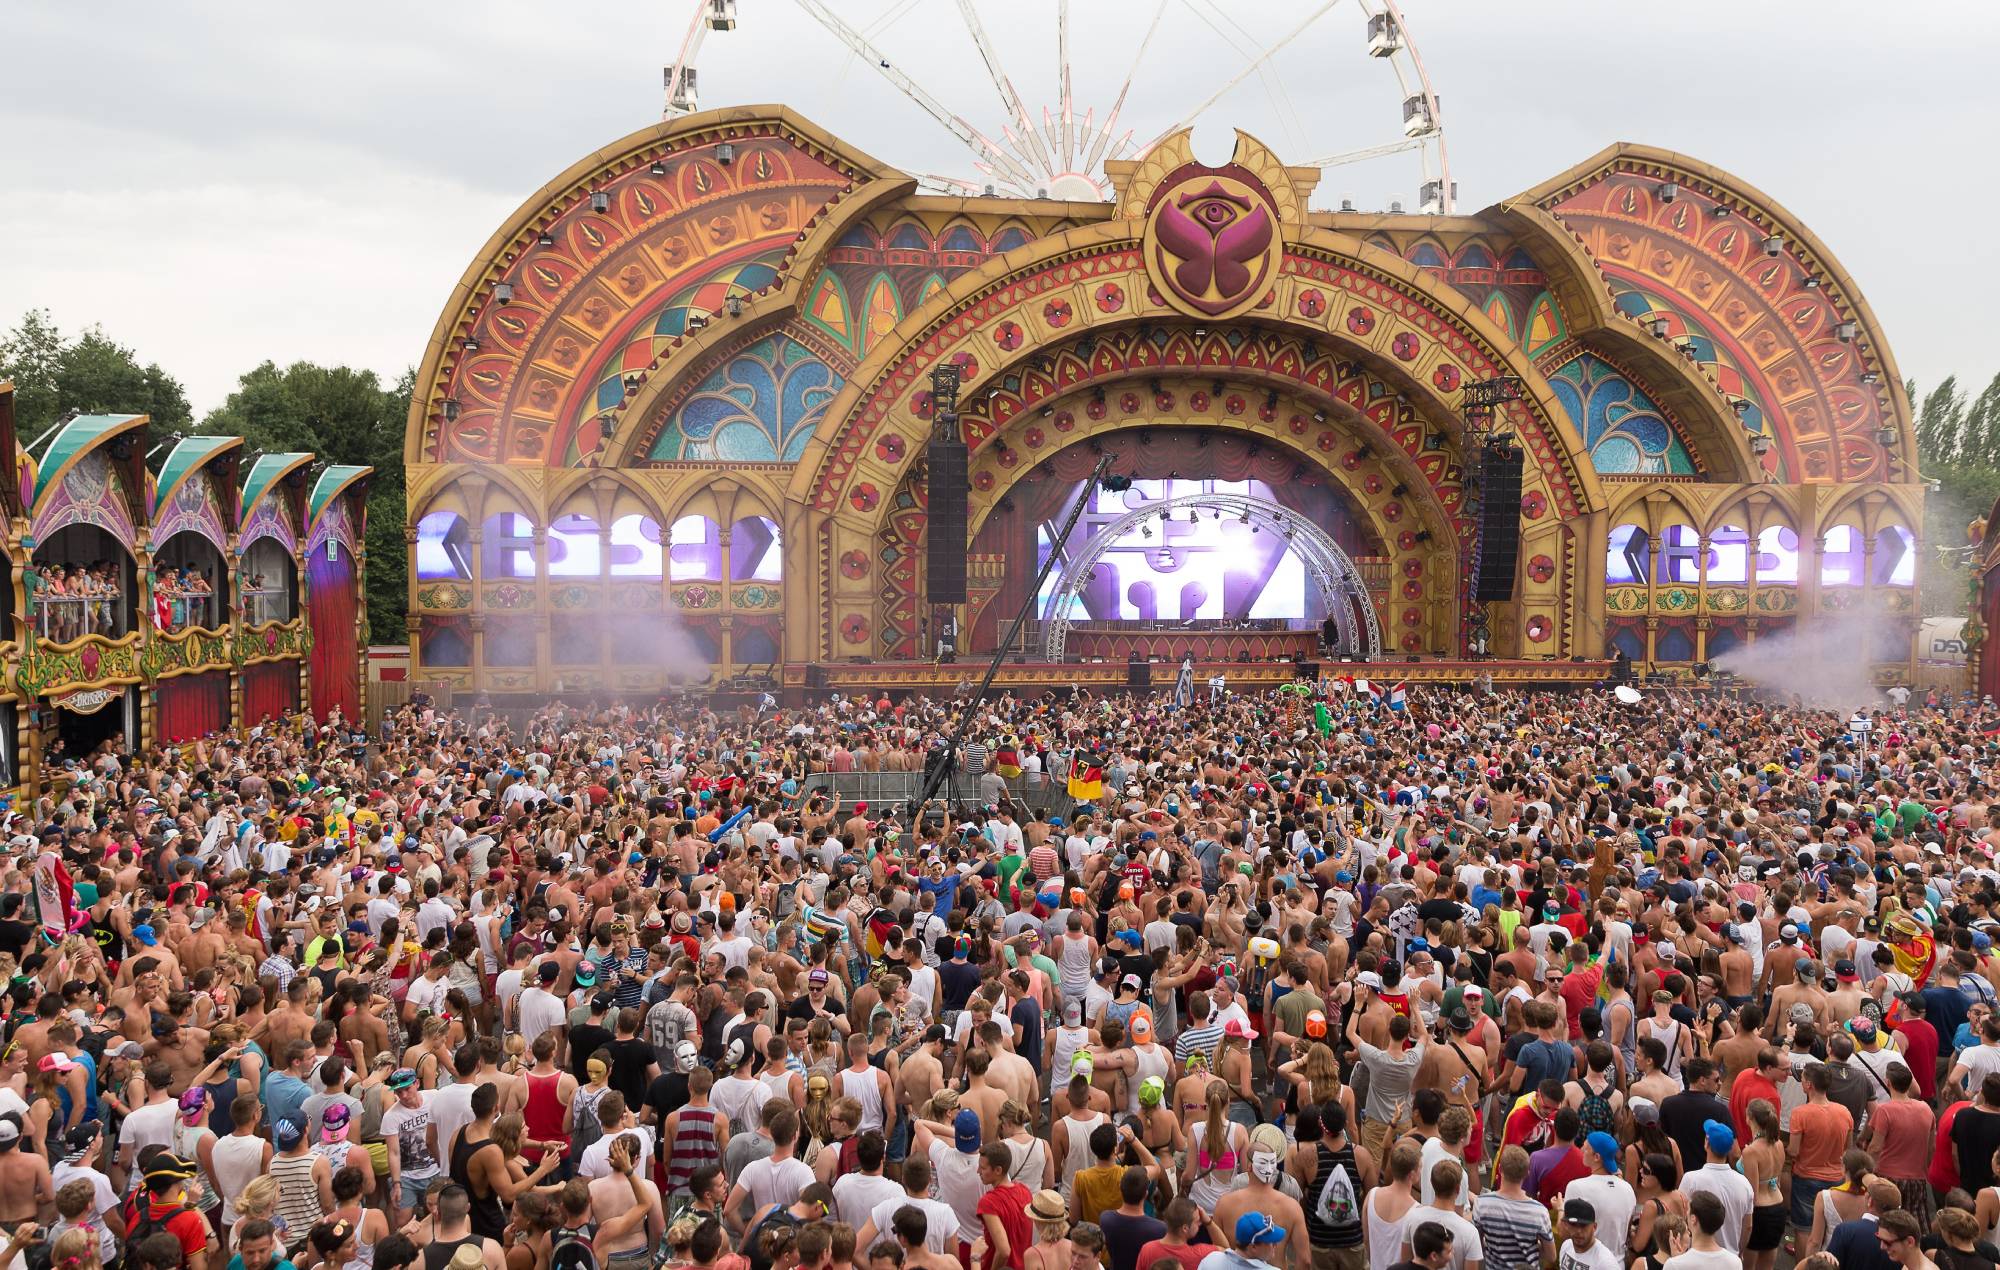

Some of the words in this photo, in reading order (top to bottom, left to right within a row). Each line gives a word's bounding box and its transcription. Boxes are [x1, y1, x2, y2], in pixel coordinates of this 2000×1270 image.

[1933, 638, 1968, 654] DSV
[75, 688, 104, 707] DRINKS
[651, 1019, 679, 1049] 69
